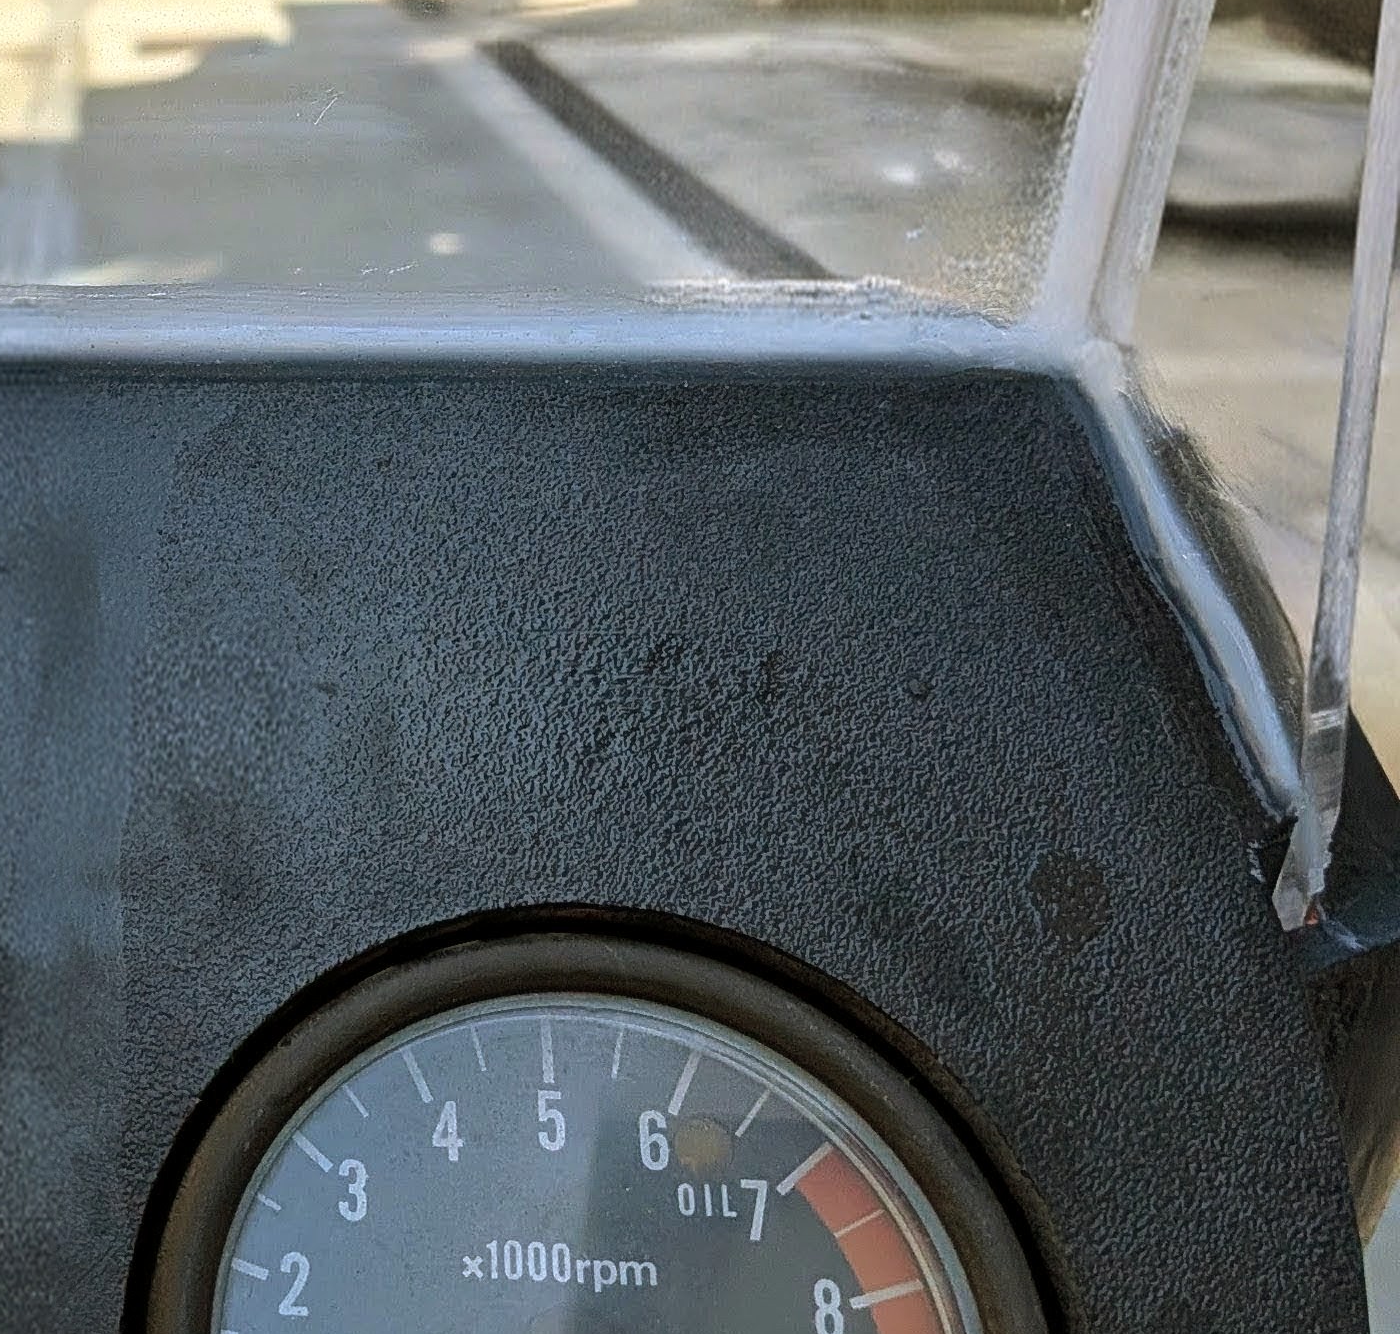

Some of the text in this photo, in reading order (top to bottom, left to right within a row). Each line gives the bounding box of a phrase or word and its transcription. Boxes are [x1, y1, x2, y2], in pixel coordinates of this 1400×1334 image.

[432, 1101, 463, 1161] 4
[536, 1091, 567, 1151] 5
[639, 1110, 669, 1171] 6
[338, 1160, 368, 1222] 3
[677, 1183, 738, 1218] OIL
[740, 1178, 768, 1242] 7
[280, 1252, 309, 1317] 2
